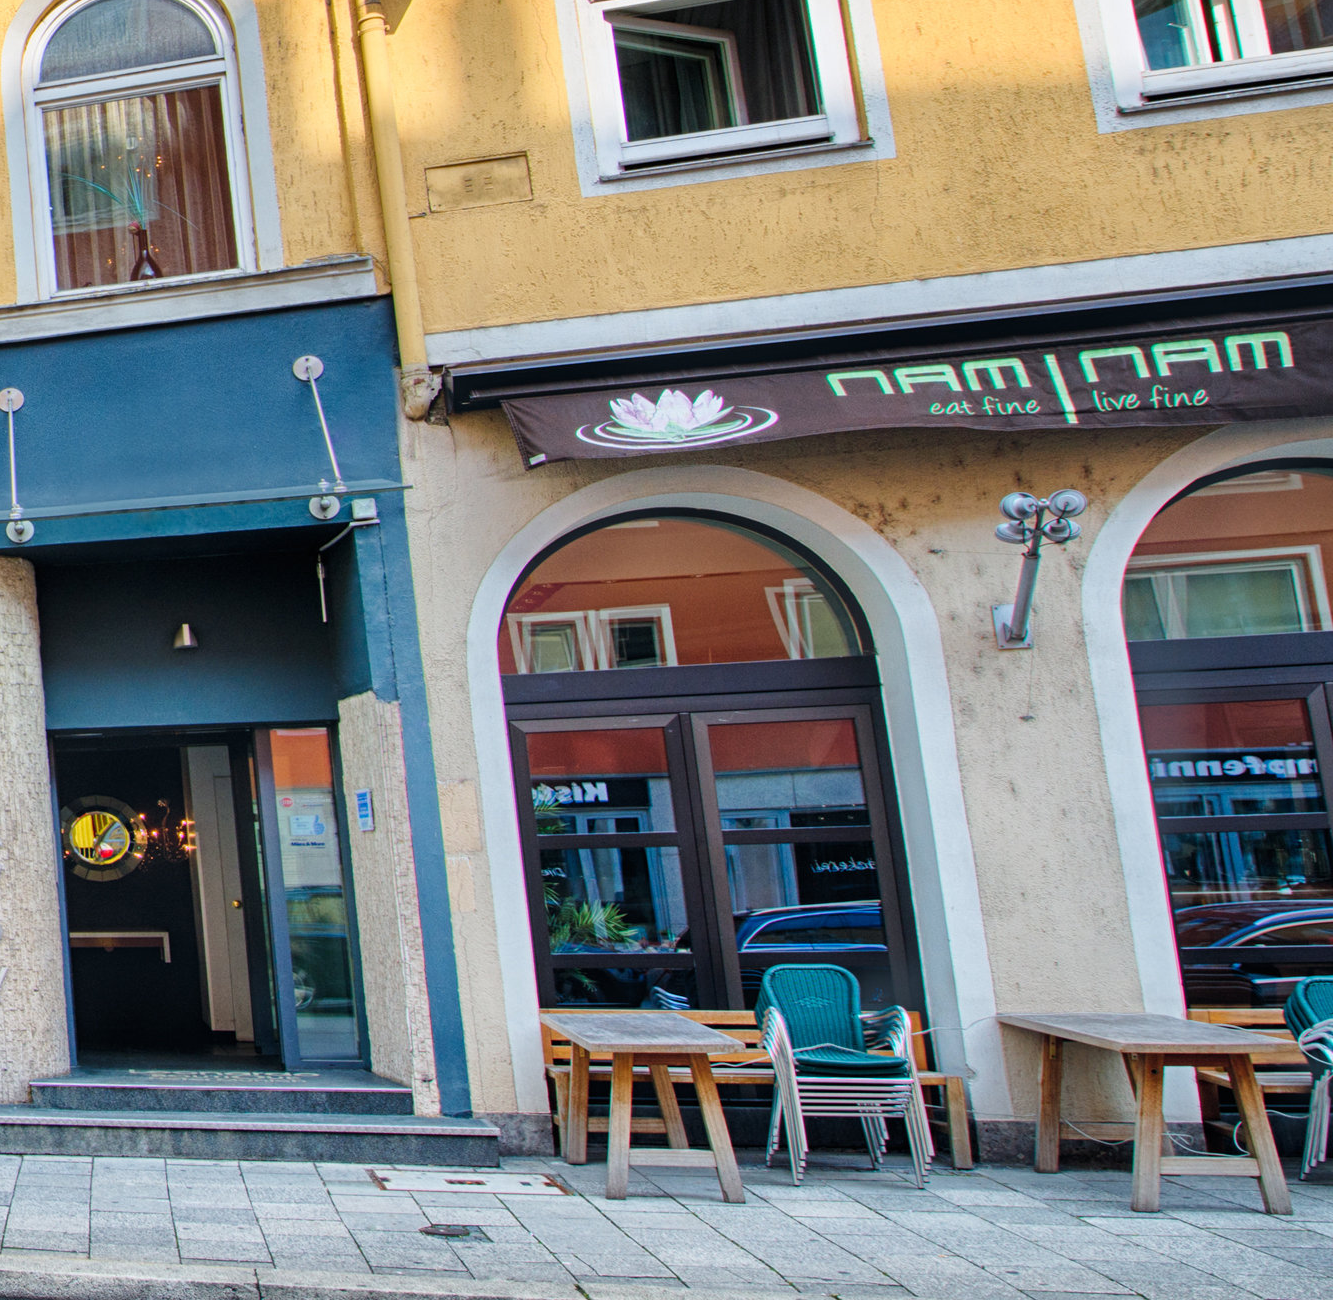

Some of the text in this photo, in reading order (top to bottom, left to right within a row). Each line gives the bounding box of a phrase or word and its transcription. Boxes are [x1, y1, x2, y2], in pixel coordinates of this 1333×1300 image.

[930, 395, 1041, 416] eat fine
[1093, 384, 1209, 413] live fine
